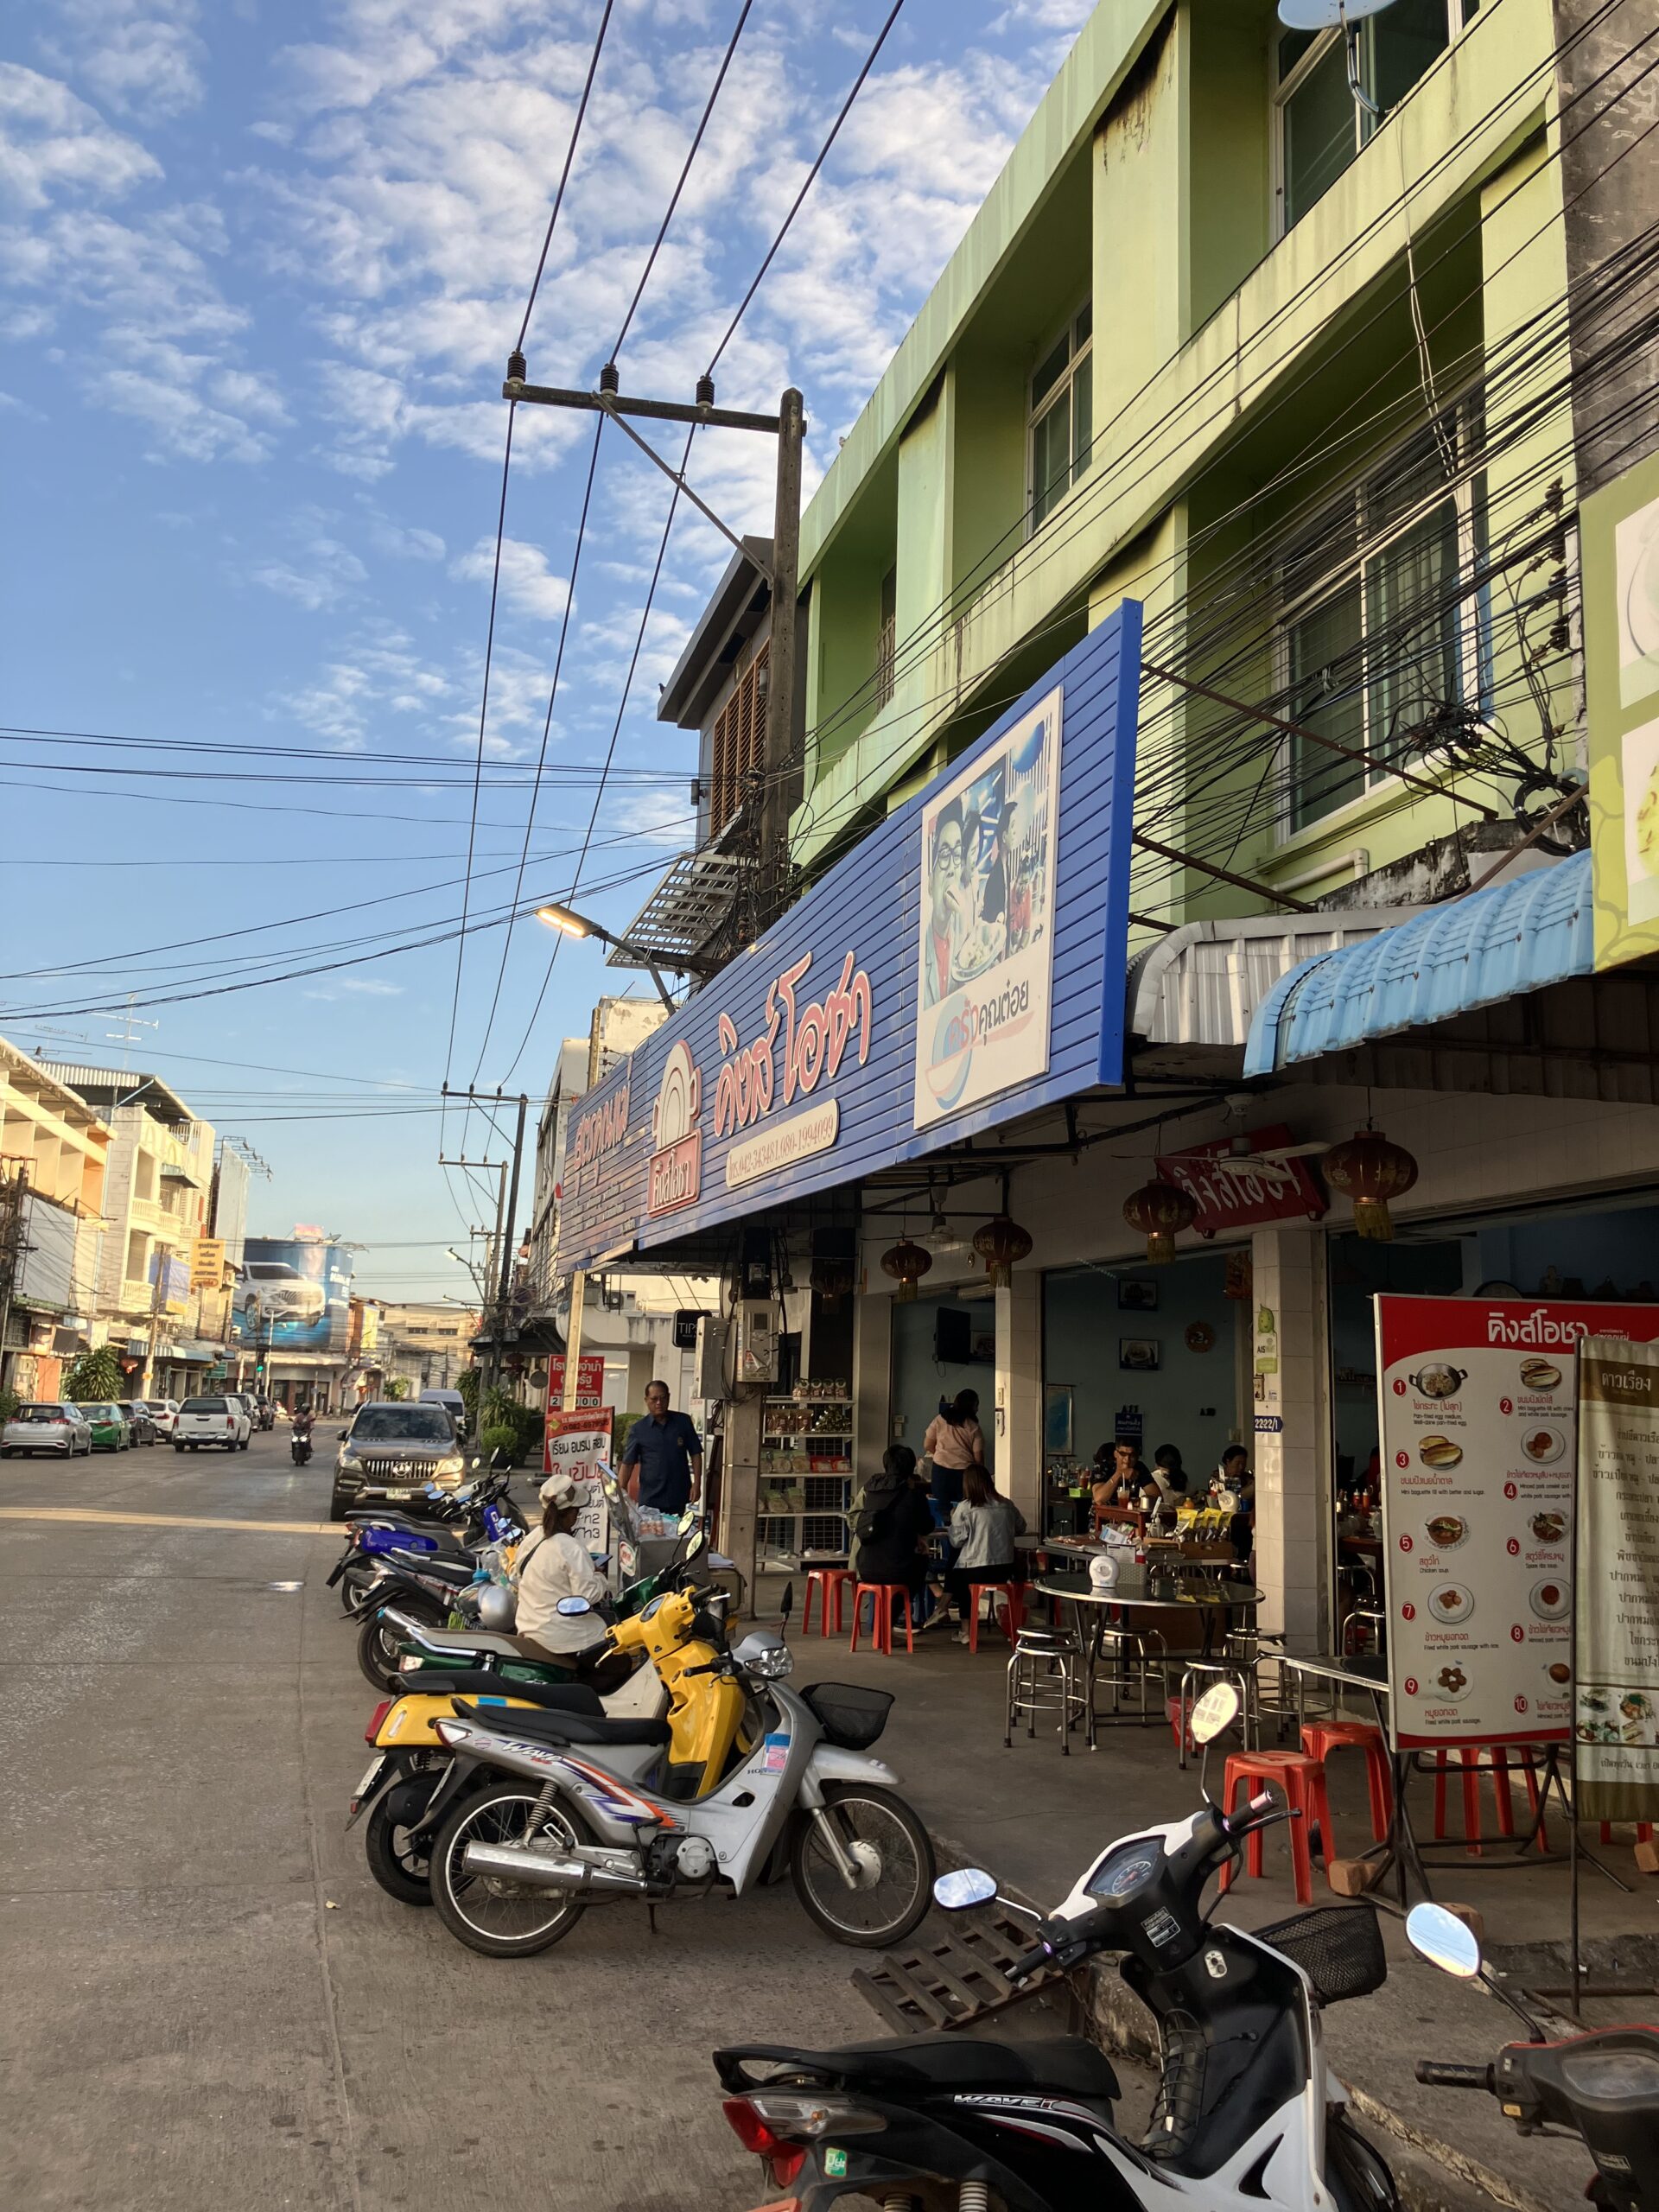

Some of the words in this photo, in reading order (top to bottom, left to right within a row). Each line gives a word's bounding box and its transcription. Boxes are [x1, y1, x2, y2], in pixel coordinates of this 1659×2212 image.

[677, 1322, 698, 1335] TIP
[1396, 1381, 1403, 1393] 1
[1601, 1370, 1652, 1391] ดาวเรือง
[1503, 1400, 1510, 1412] 2
[553, 1440, 569, 1455] เรียน
[571, 1440, 591, 1452] อบรม
[1400, 1453, 1406, 1465] 3
[1507, 1484, 1514, 1497] 4
[1402, 1536, 1409, 1549] 5
[1510, 1540, 1517, 1553] 6
[1406, 1605, 1412, 1618] 7
[1514, 1628, 1520, 1640] 8
[1408, 1679, 1414, 1692] 9
[1515, 1698, 1527, 1710] 10
[502, 1742, 563, 1762] Wave
